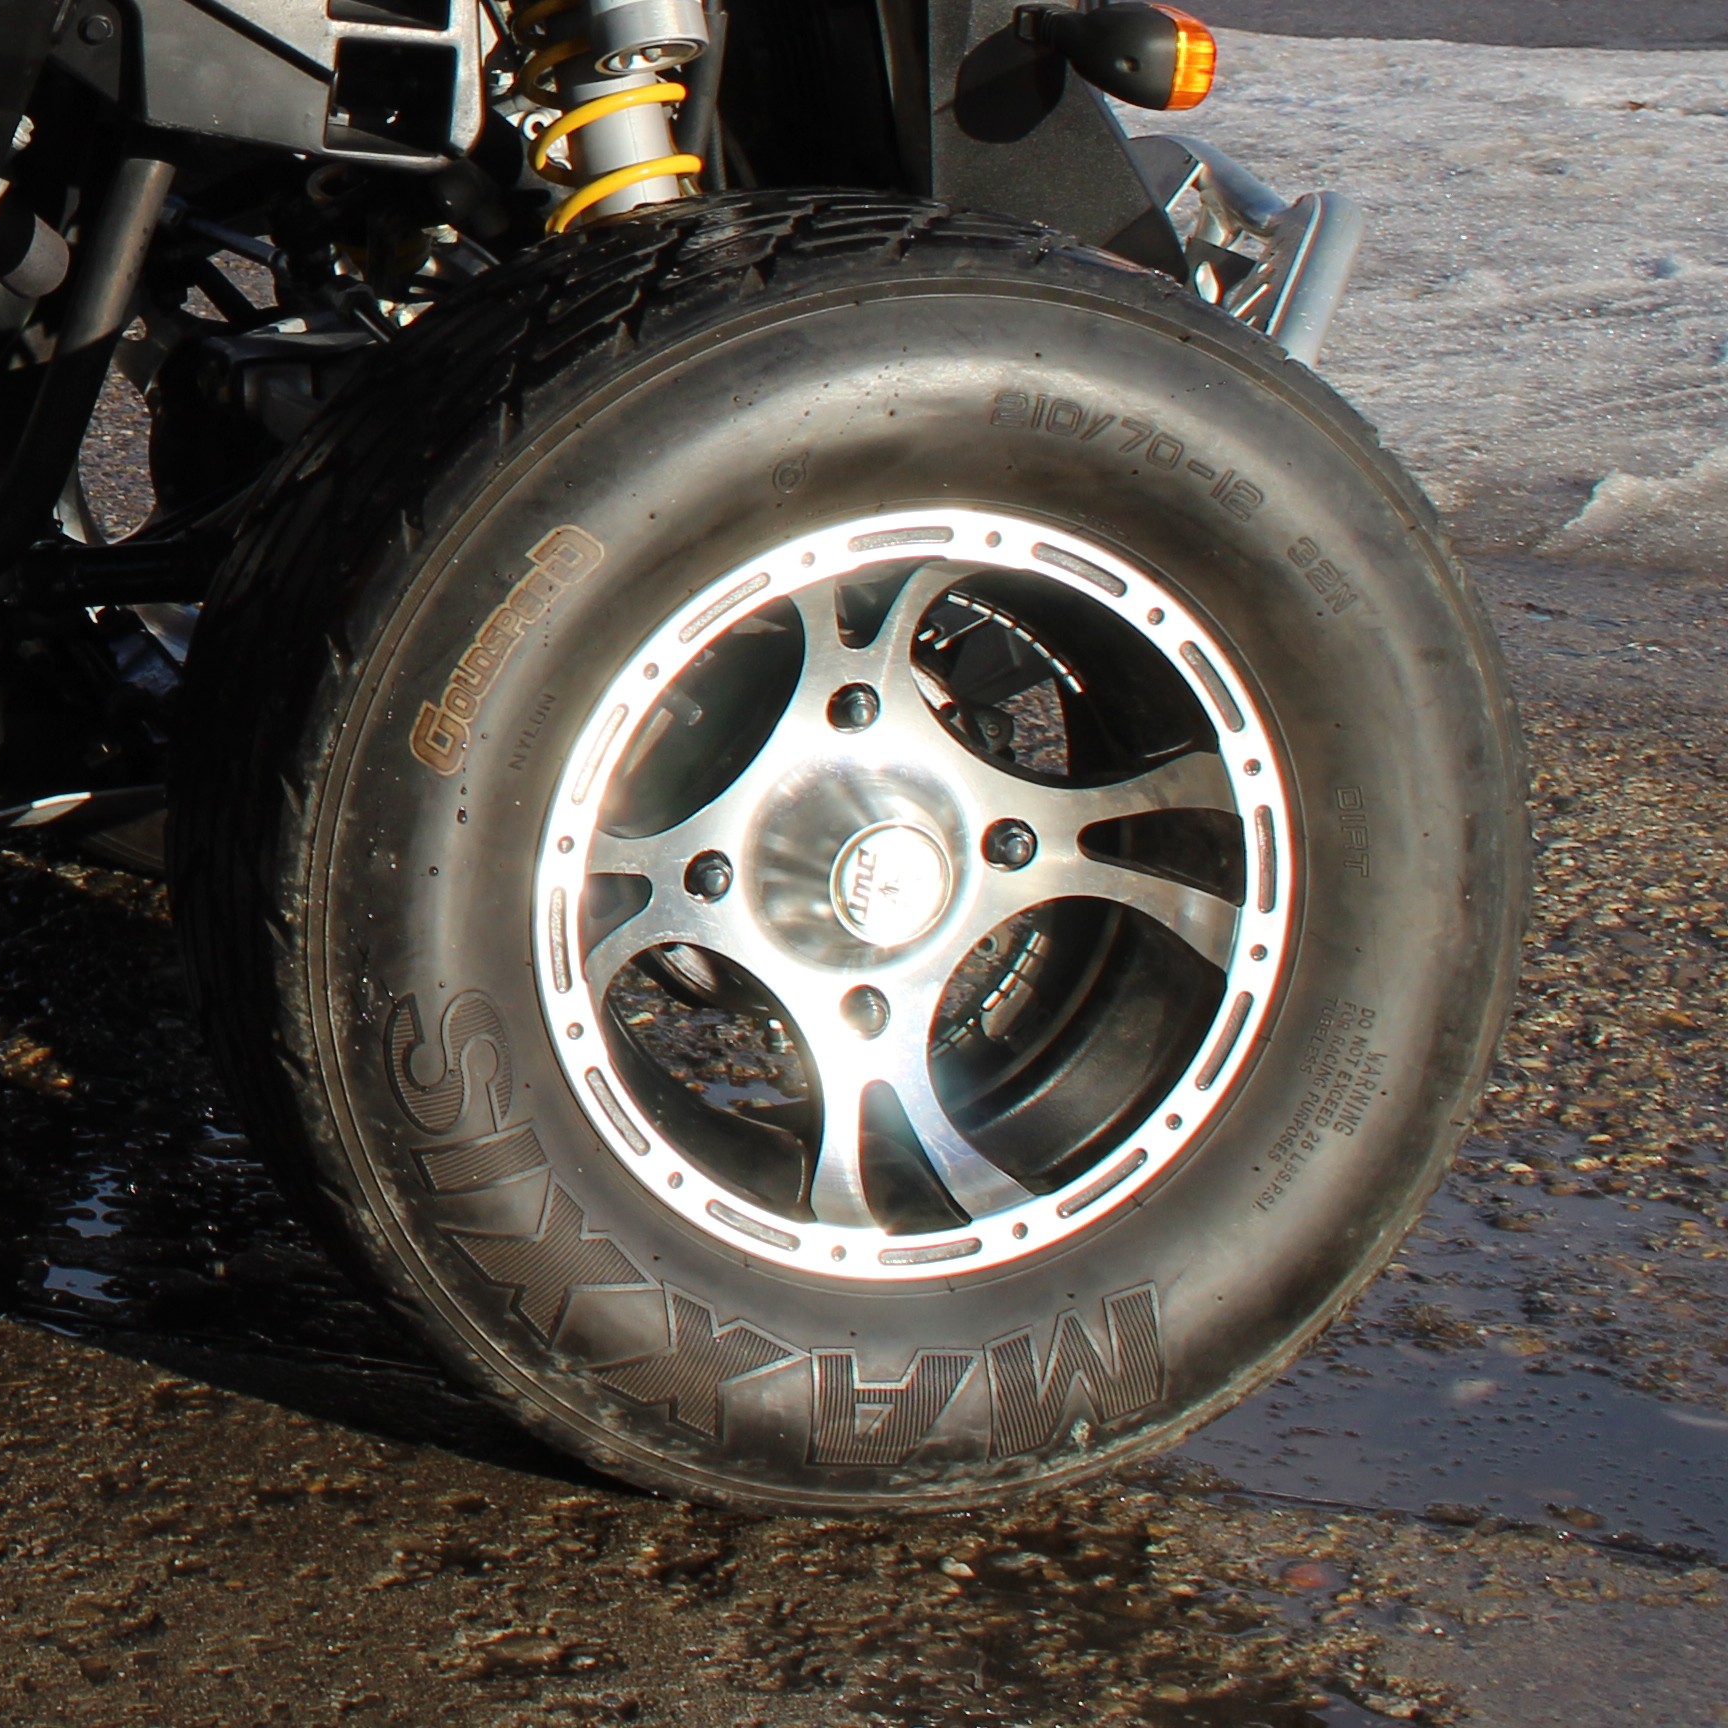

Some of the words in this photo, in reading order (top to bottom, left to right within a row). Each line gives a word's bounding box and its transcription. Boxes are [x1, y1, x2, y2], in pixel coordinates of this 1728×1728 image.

[990, 390, 1267, 525] 210/70-12
[1286, 535, 1360, 618] 32N
[408, 522, 606, 778] GOLDSPEED
[507, 690, 558, 773] NYLON
[1332, 784, 1372, 878] DIRT
[1298, 997, 1339, 1074] TUBELESS
[1337, 1001, 1358, 1032] FOR
[1344, 1034, 1368, 1068] NOT
[1357, 1007, 1377, 1030] DO
[1311, 1034, 1347, 1090] RACING
[1314, 1071, 1353, 1128] EXCEED
[1332, 1051, 1388, 1137] WARNING
[1267, 1090, 1321, 1163] PURPOSES
[383, 988, 1167, 1467] MAXXIS
